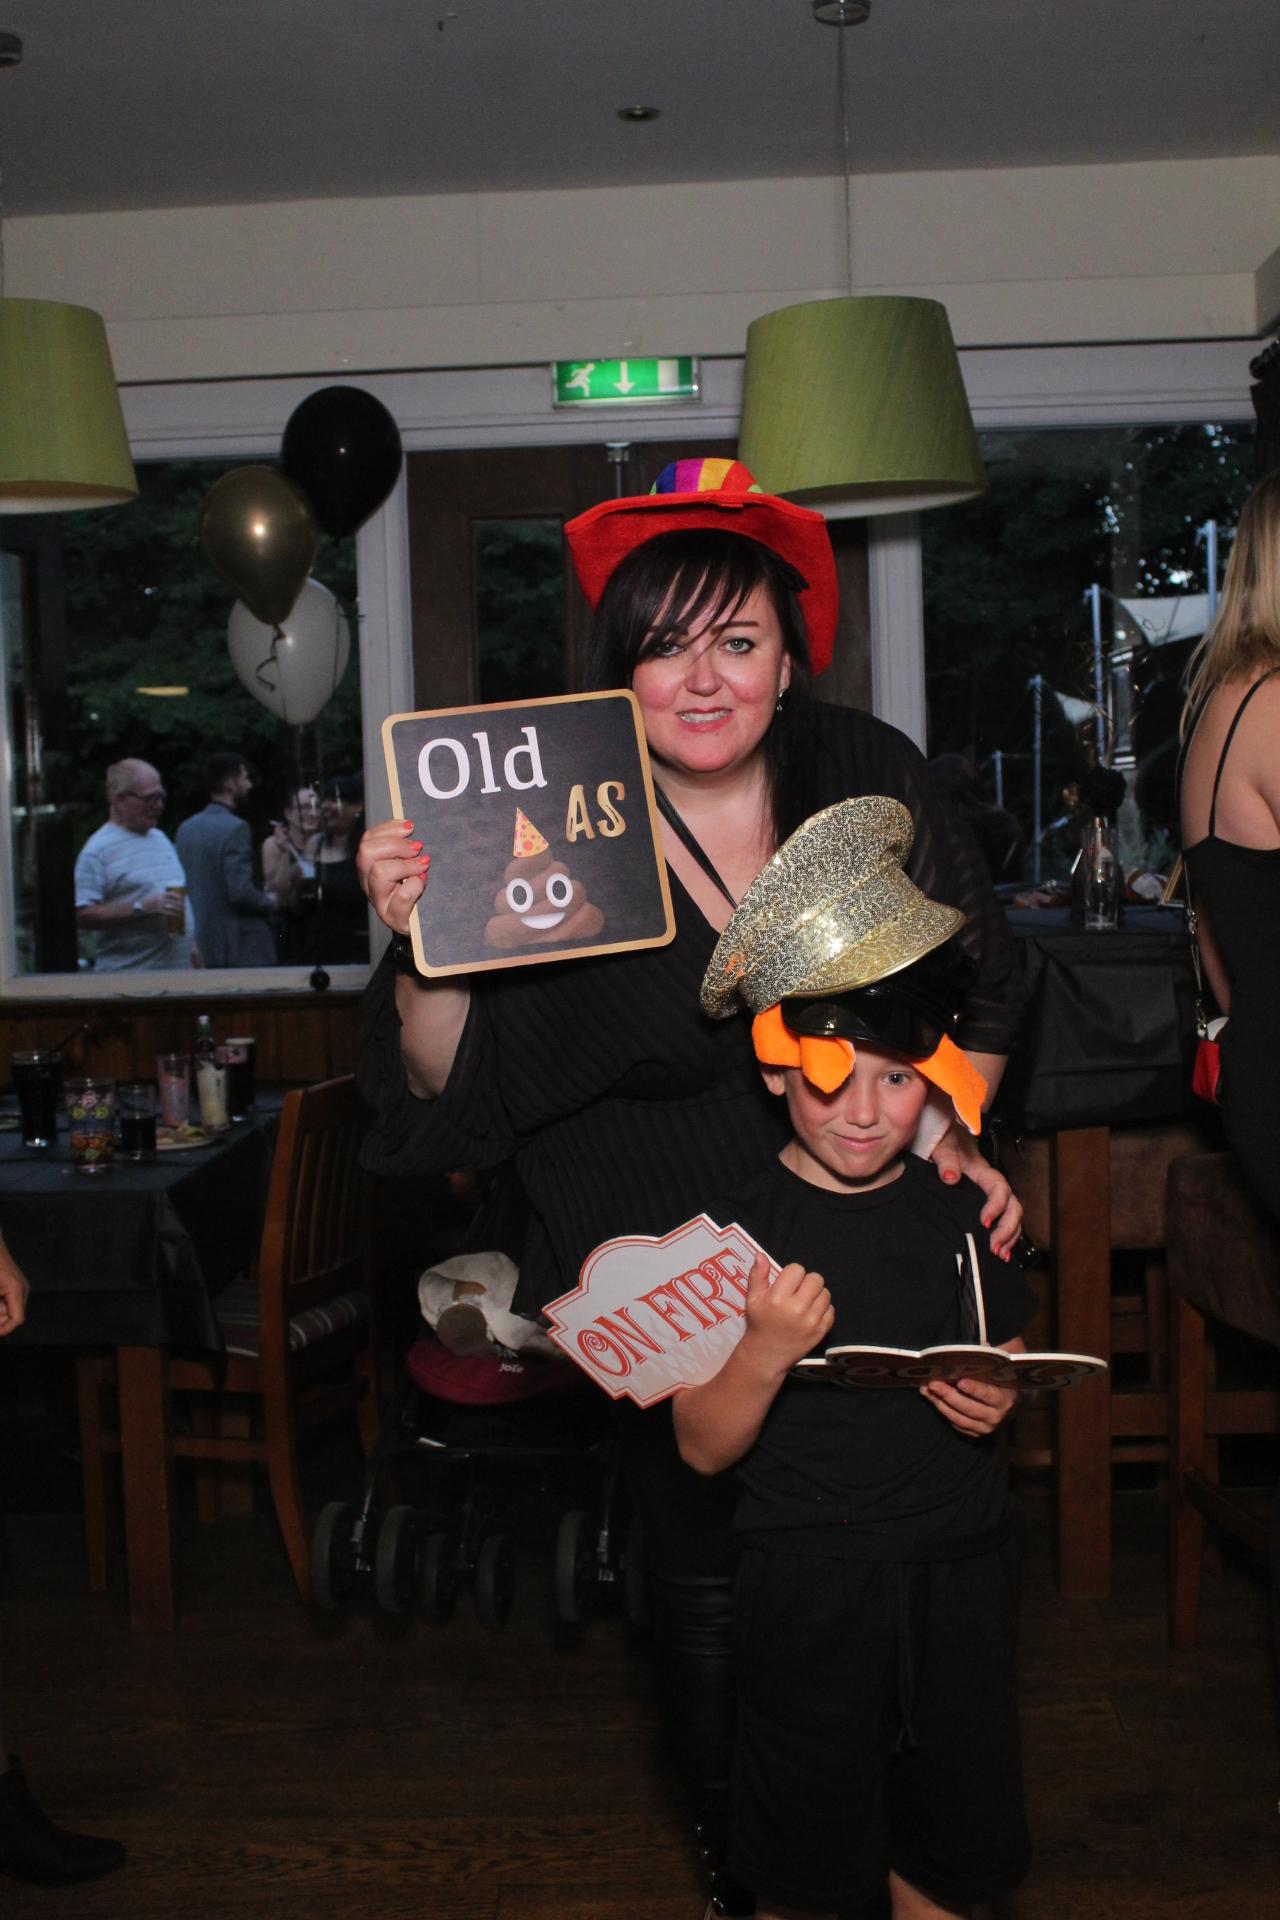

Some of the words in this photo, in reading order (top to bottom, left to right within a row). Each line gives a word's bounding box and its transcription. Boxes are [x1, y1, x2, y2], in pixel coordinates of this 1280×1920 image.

[418, 726, 548, 800] Old
[566, 781, 627, 842] AS
[577, 1306, 666, 1377] ON
[634, 1247, 750, 1342] FIRE
